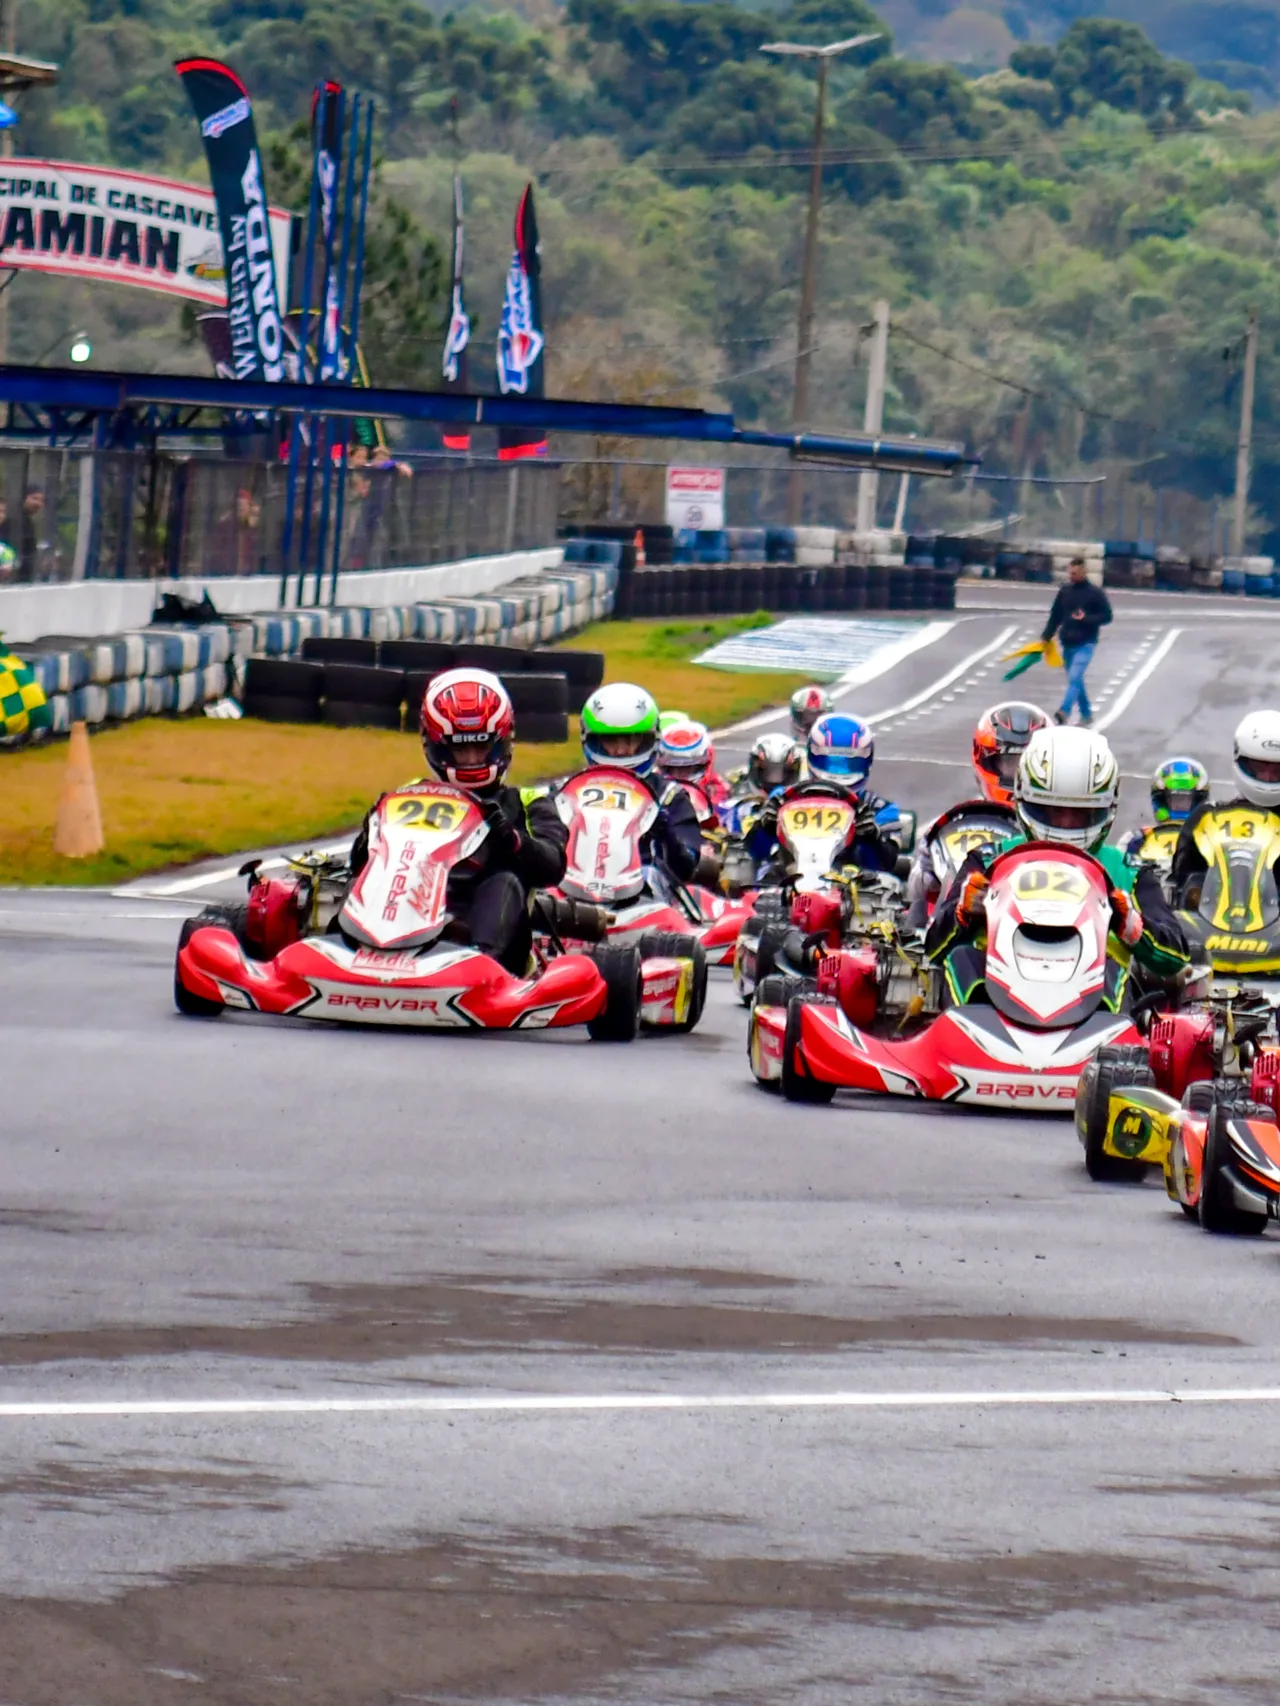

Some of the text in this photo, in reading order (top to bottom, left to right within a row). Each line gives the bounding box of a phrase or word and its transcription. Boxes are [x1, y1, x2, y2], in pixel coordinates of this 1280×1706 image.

[70, 184, 97, 205] DE
[107, 190, 217, 231] CASCAVE
[228, 213, 247, 253] by
[451, 733, 489, 743] EIKO
[395, 786, 461, 799] BRAVAR
[582, 788, 628, 811] 21
[394, 799, 456, 829] 26
[793, 812, 841, 831] 912
[1219, 820, 1255, 839] 13
[382, 841, 416, 922] BRAVAR
[1018, 869, 1081, 897] 02
[1230, 907, 1246, 918] M
[1204, 936, 1270, 955] Mini
[327, 993, 439, 1015] BRAVAR
[975, 1082, 1077, 1100] BRAVA
[1122, 1116, 1141, 1135] M
